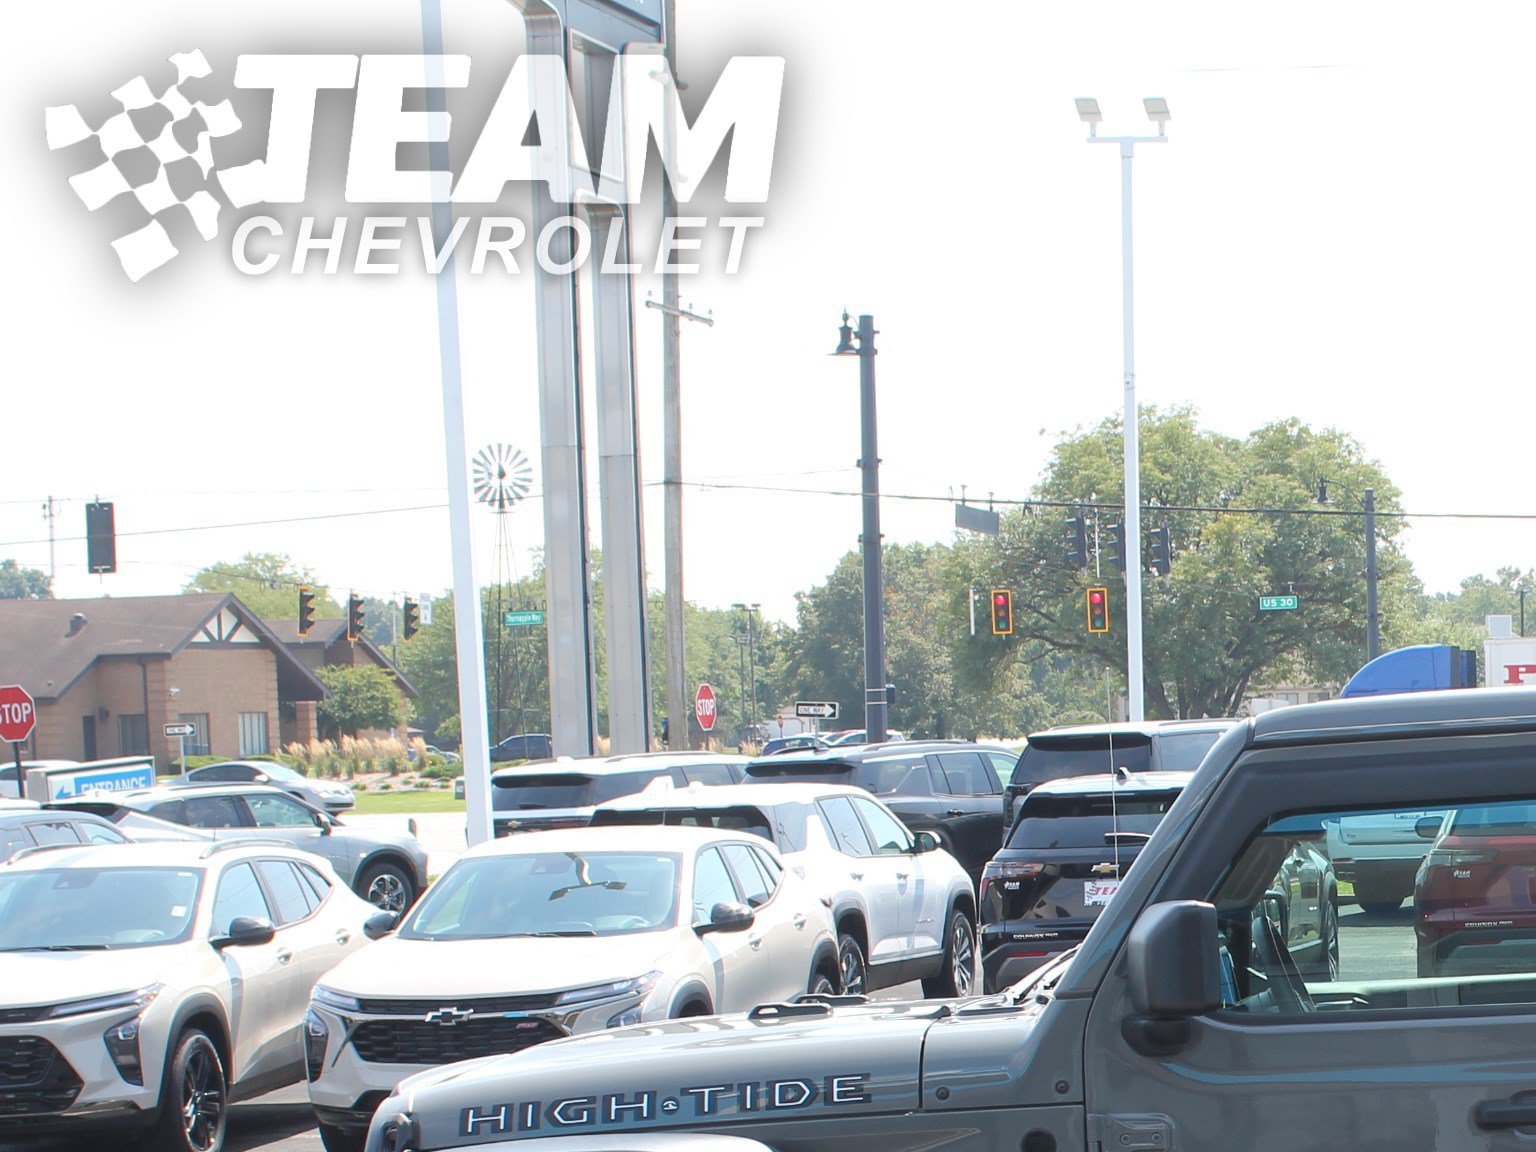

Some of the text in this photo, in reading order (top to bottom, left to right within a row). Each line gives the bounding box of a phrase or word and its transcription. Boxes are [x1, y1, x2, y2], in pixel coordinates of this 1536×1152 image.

[1263, 598, 1293, 607] US 30
[0, 702, 31, 724] TOP
[697, 699, 714, 716] STOP
[459, 1072, 872, 1137] HIGH TIDE
